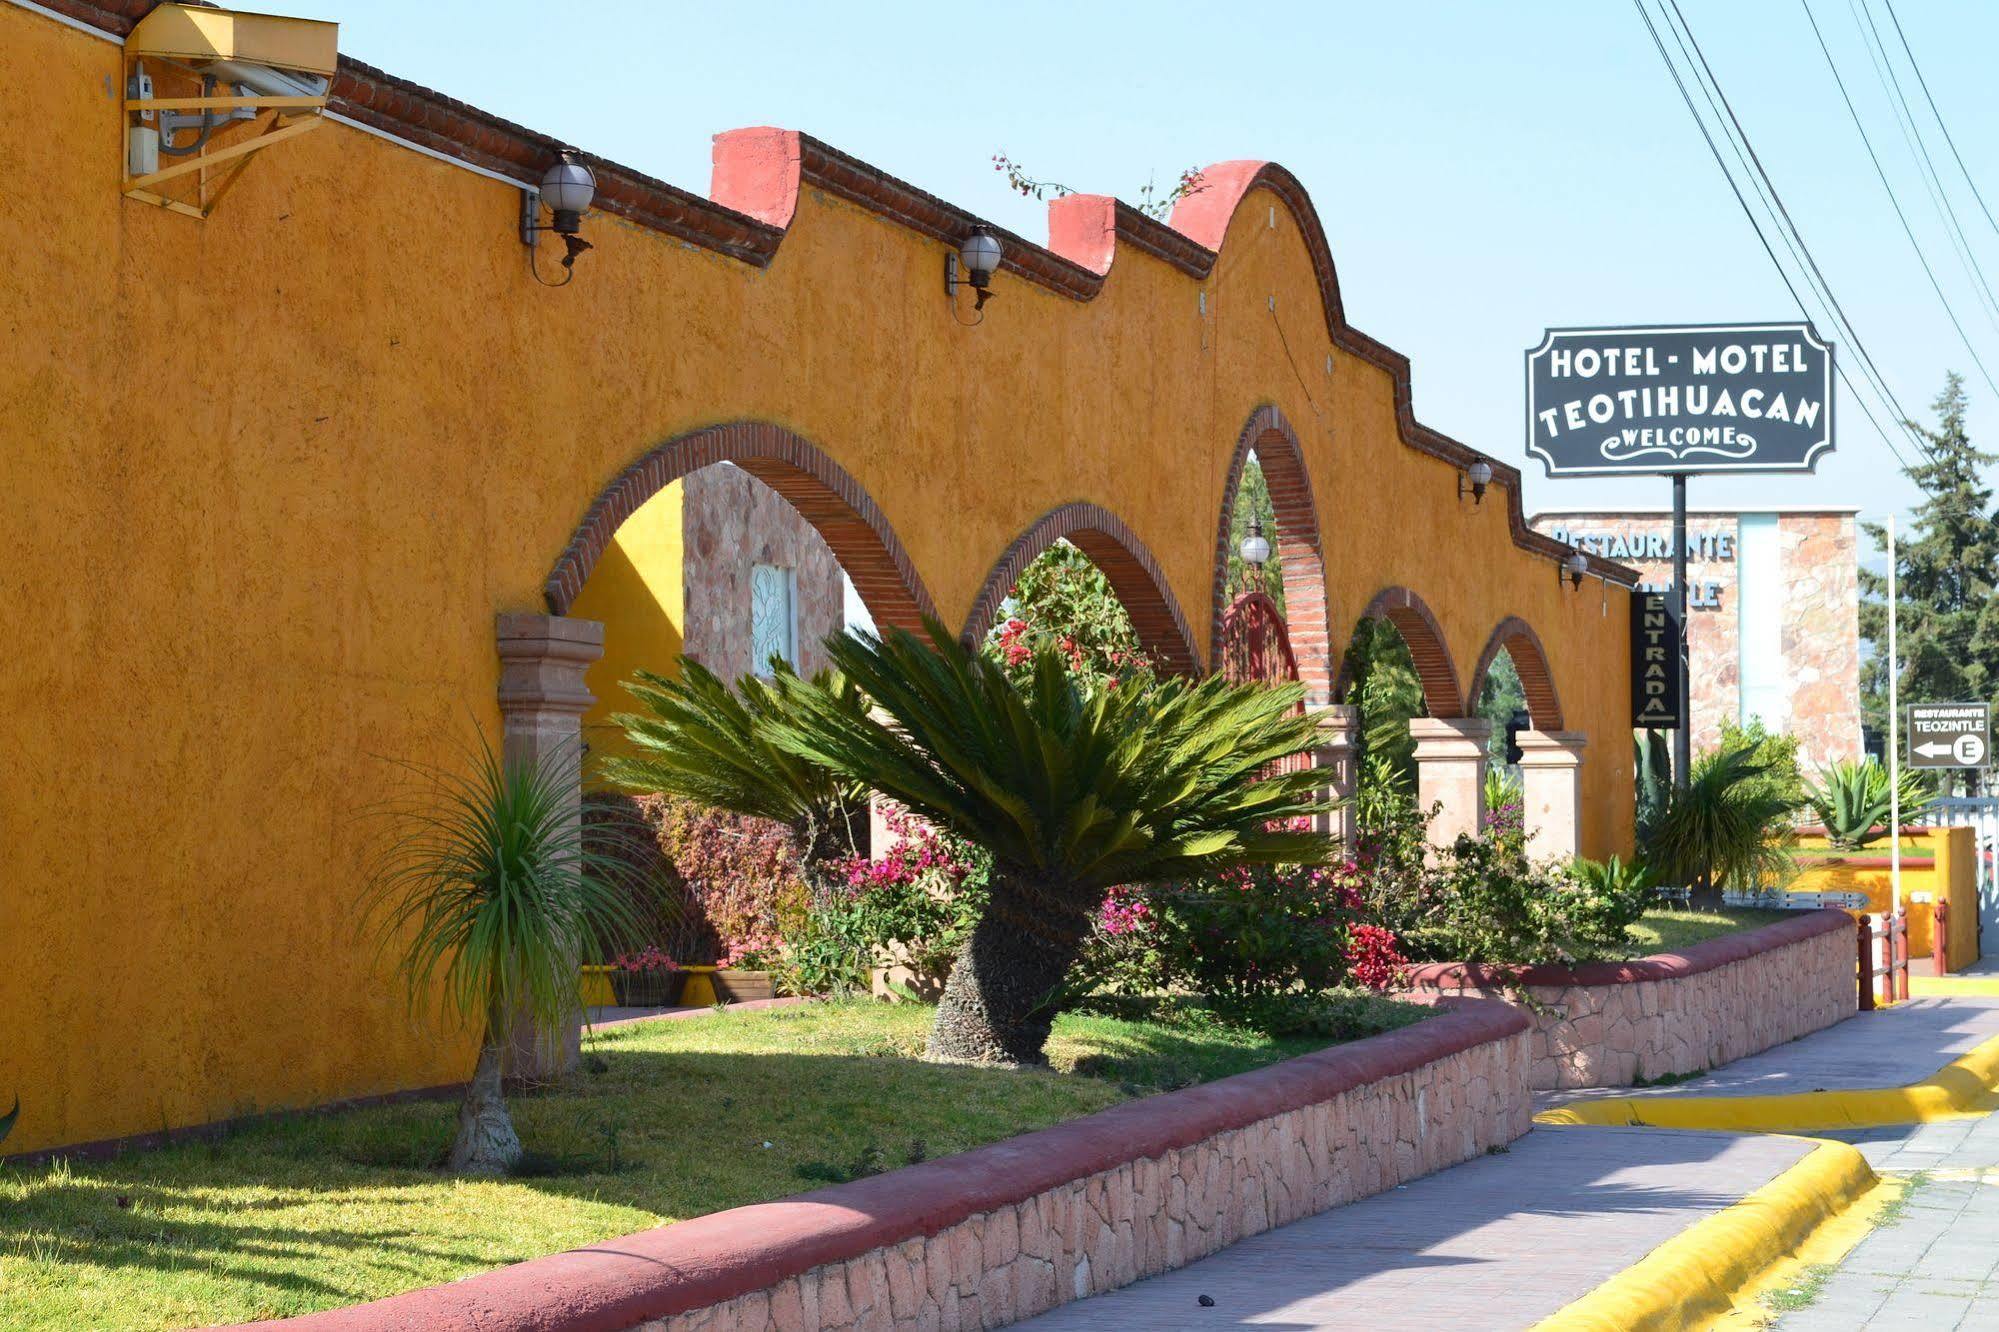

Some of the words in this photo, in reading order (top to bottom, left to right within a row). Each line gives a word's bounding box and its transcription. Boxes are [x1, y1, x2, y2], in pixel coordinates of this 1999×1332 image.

[1551, 347, 1659, 377] HOTEL
[1693, 344, 1807, 375] MOTEL
[1539, 385, 1820, 438] TEOTIHUACAN
[1622, 427, 1736, 447] WELCOME
[1644, 595, 1665, 712] ENTRADA
[1914, 708, 1985, 718] RESTAURANTE
[1914, 720, 1985, 732] TEOZINTLE
[1961, 741, 1976, 758] E
